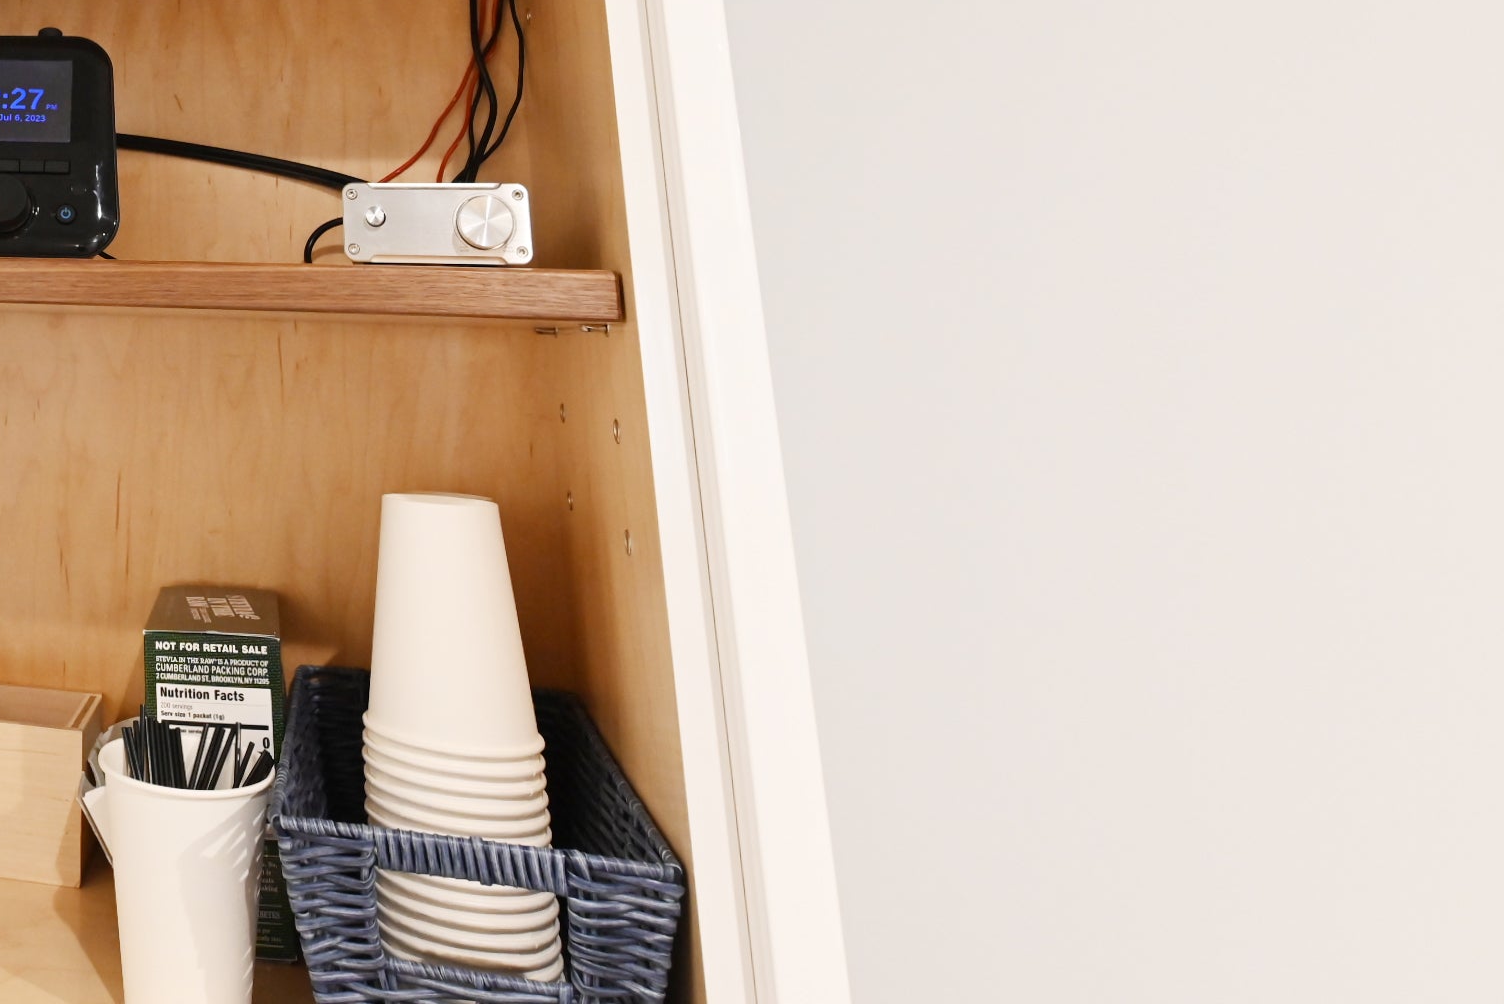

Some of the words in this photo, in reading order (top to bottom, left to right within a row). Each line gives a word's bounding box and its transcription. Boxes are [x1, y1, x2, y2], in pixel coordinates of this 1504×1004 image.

[14, 114, 23, 123] 6,
[25, 114, 46, 123] 2023
[155, 641, 176, 651] NOT
[180, 642, 200, 652] FOR
[203, 643, 238, 653] RETAIL
[242, 645, 268, 655] SALE
[230, 659, 259, 667] PRODUCT
[156, 663, 209, 674] CUMBERLAND
[211, 667, 245, 676] PACKING
[247, 668, 269, 677] CORP.
[160, 672, 201, 682] CUMBERLAND
[160, 686, 210, 700] Nutrition
[214, 690, 245, 701] Facts
[172, 703, 193, 711] servings
[262, 737, 270, 749] 0
